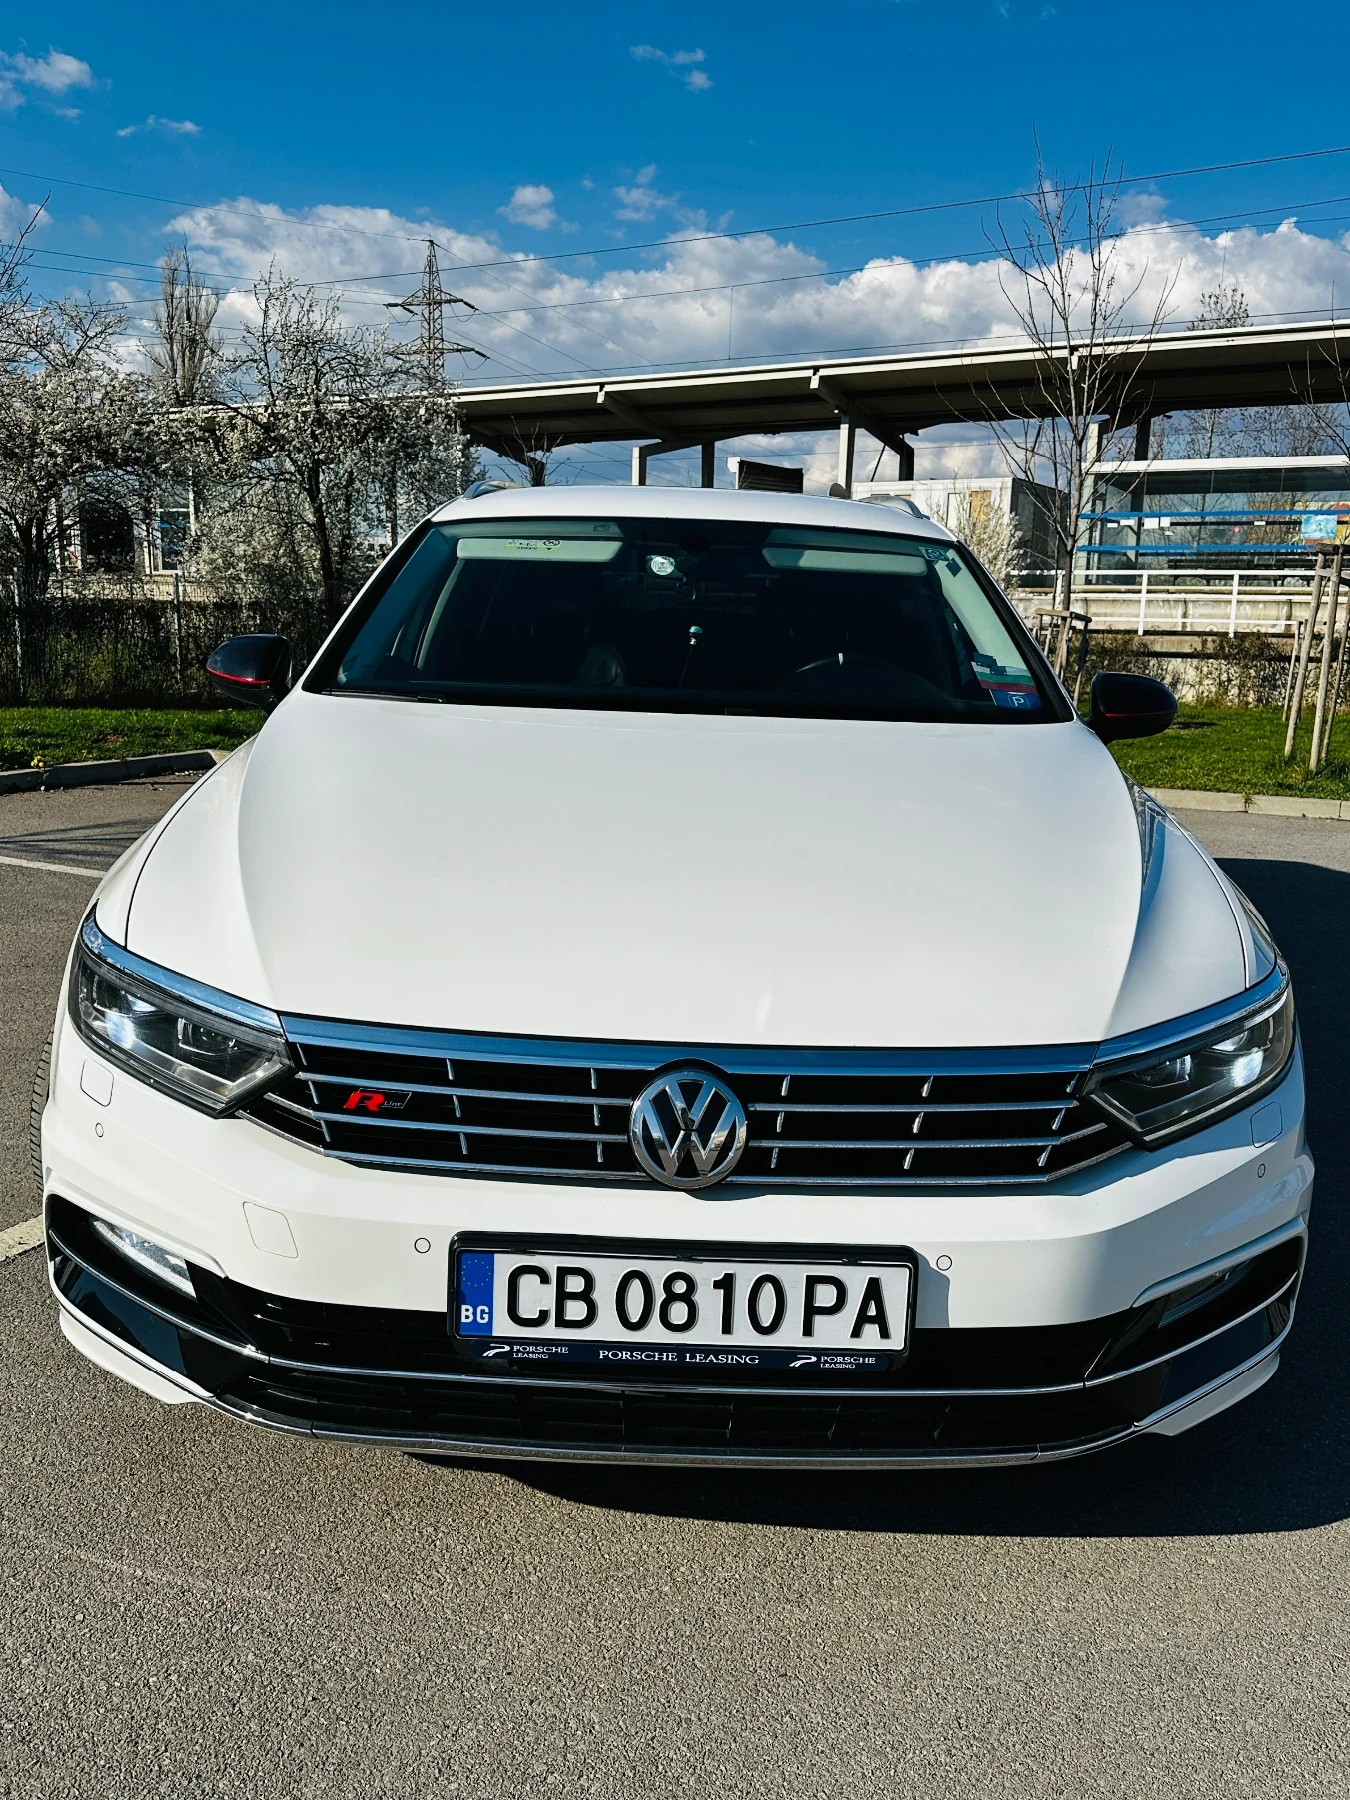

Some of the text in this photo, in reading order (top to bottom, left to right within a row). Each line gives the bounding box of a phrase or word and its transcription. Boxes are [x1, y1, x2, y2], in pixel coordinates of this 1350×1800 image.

[343, 1091, 385, 1112] R
[630, 1069, 747, 1188] VW
[506, 1264, 891, 1340] CB 0810 PA
[460, 1304, 489, 1323] BG
[513, 1345, 569, 1354] PORSCHE
[599, 1350, 760, 1364] PORSCHE LEASING
[820, 1356, 876, 1364] PORSCHE
